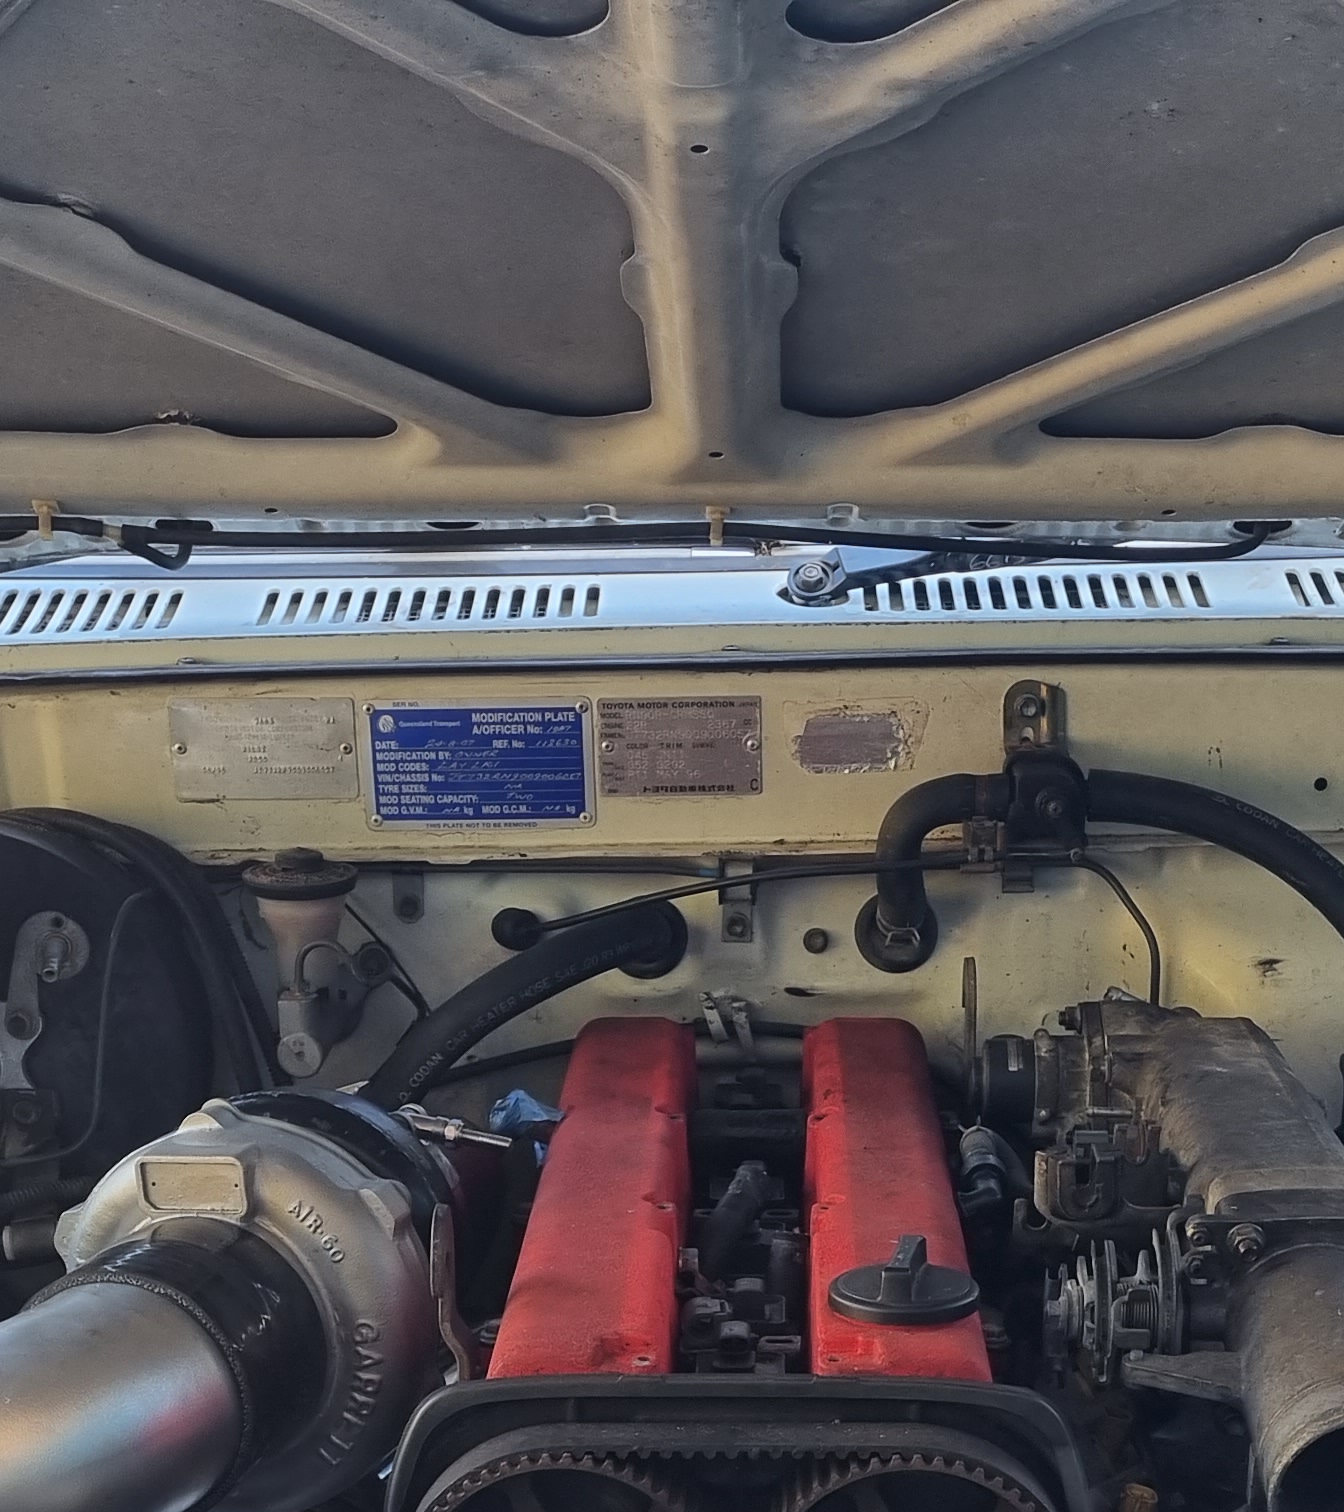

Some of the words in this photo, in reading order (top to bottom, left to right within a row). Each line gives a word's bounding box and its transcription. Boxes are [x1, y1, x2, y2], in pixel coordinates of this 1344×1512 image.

[602, 702, 634, 710] TOYOTA
[637, 701, 668, 709] MOTOR
[671, 700, 735, 708] CORPORATION
[471, 712, 542, 723] MODIFICATION
[544, 711, 576, 722] PLATE
[472, 724, 525, 735] A/OFFICER
[527, 724, 543, 734] No:
[375, 740, 399, 749] DATE:
[492, 739, 511, 748] REF.
[512, 739, 525, 748] No:
[376, 752, 436, 761] MODIFICATION
[438, 751, 452, 760] BY:
[377, 763, 397, 771] MOD
[399, 762, 429, 771] CODES:
[377, 774, 429, 782] VIN/CHASSIS
[431, 773, 445, 782] No:
[378, 784, 399, 793] TYRE
[401, 783, 427, 792] SIZES:
[750, 778, 759, 791] C
[379, 795, 398, 804] MOD
[399, 795, 435, 804] SEATING
[438, 794, 479, 804] CAPACITY:
[380, 806, 399, 815] MOD
[463, 805, 474, 816] kg
[482, 805, 502, 814] MOD
[565, 804, 576, 815] kg
[409, 1053, 444, 1087] CODAN
[320, 1319, 383, 1465] GARRETT
